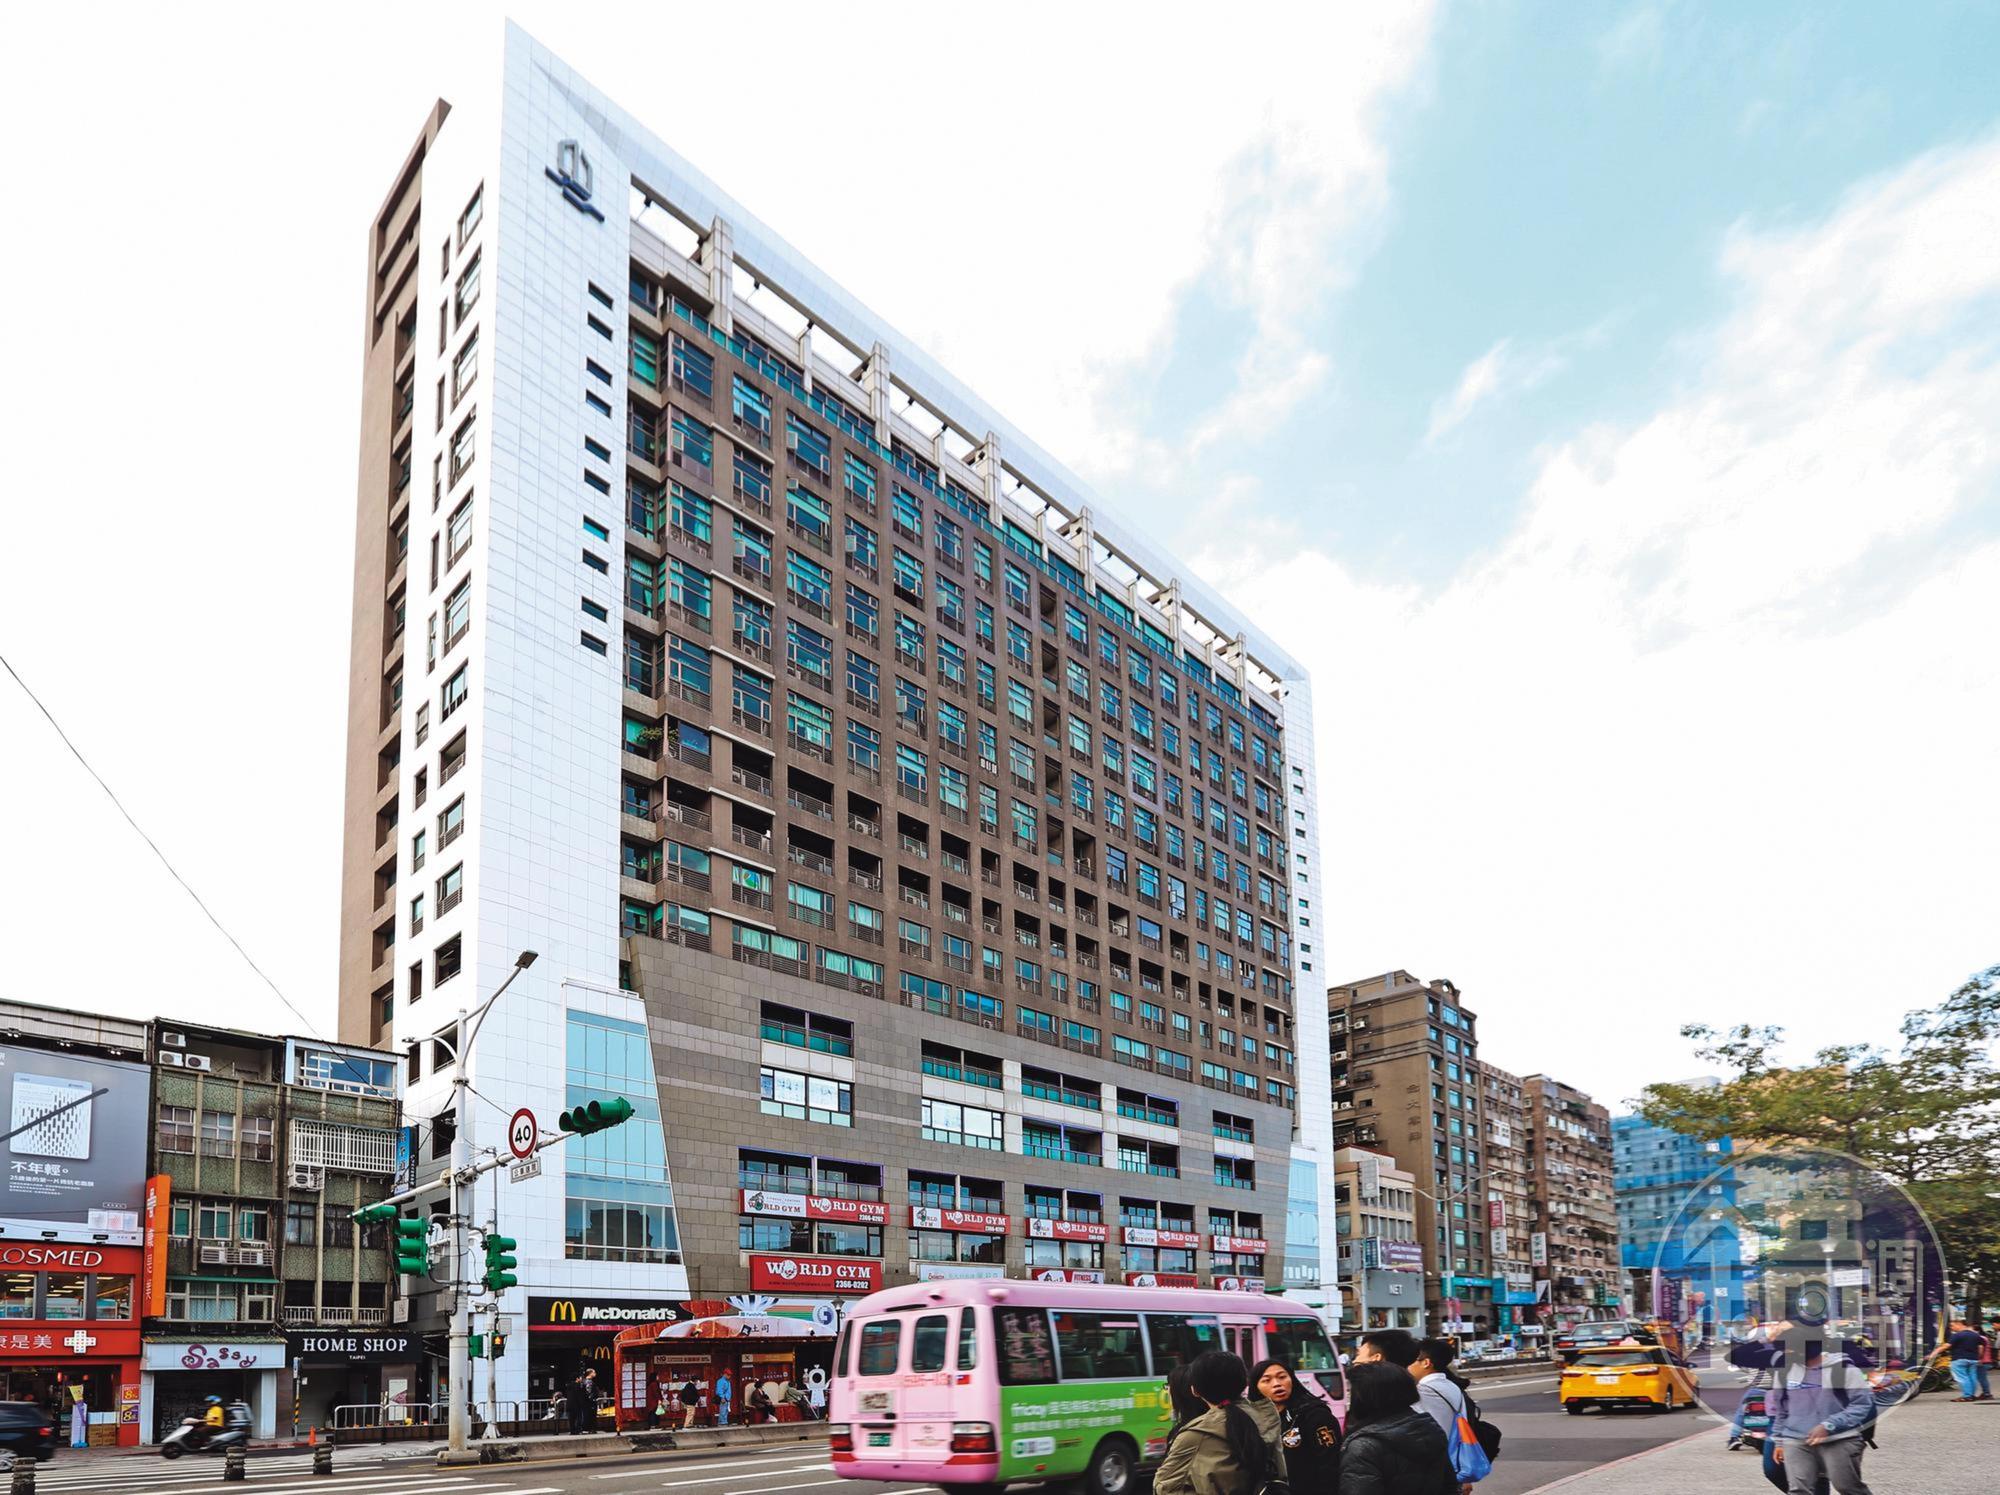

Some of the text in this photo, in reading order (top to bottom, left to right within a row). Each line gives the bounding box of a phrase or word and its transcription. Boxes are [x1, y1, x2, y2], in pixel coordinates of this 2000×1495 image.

[515, 1125, 531, 1143] 40
[11, 1161, 69, 1177] 不年輕。
[782, 1203, 801, 1213] GYM
[808, 1198, 857, 1213] WORLD
[860, 1203, 885, 1215] GYM
[945, 1211, 1006, 1226] WORLD GYM
[1056, 1221, 1087, 1234] WORLD
[1088, 1226, 1106, 1235] GYM
[1185, 1234, 1199, 1242] GYM
[0, 1246, 103, 1267] OSMED
[765, 1259, 871, 1280] WORLD GYM
[582, 1307, 677, 1321] McDonald's
[302, 1337, 408, 1352] HOME SHOP
[182, 1344, 257, 1369] Sassy
